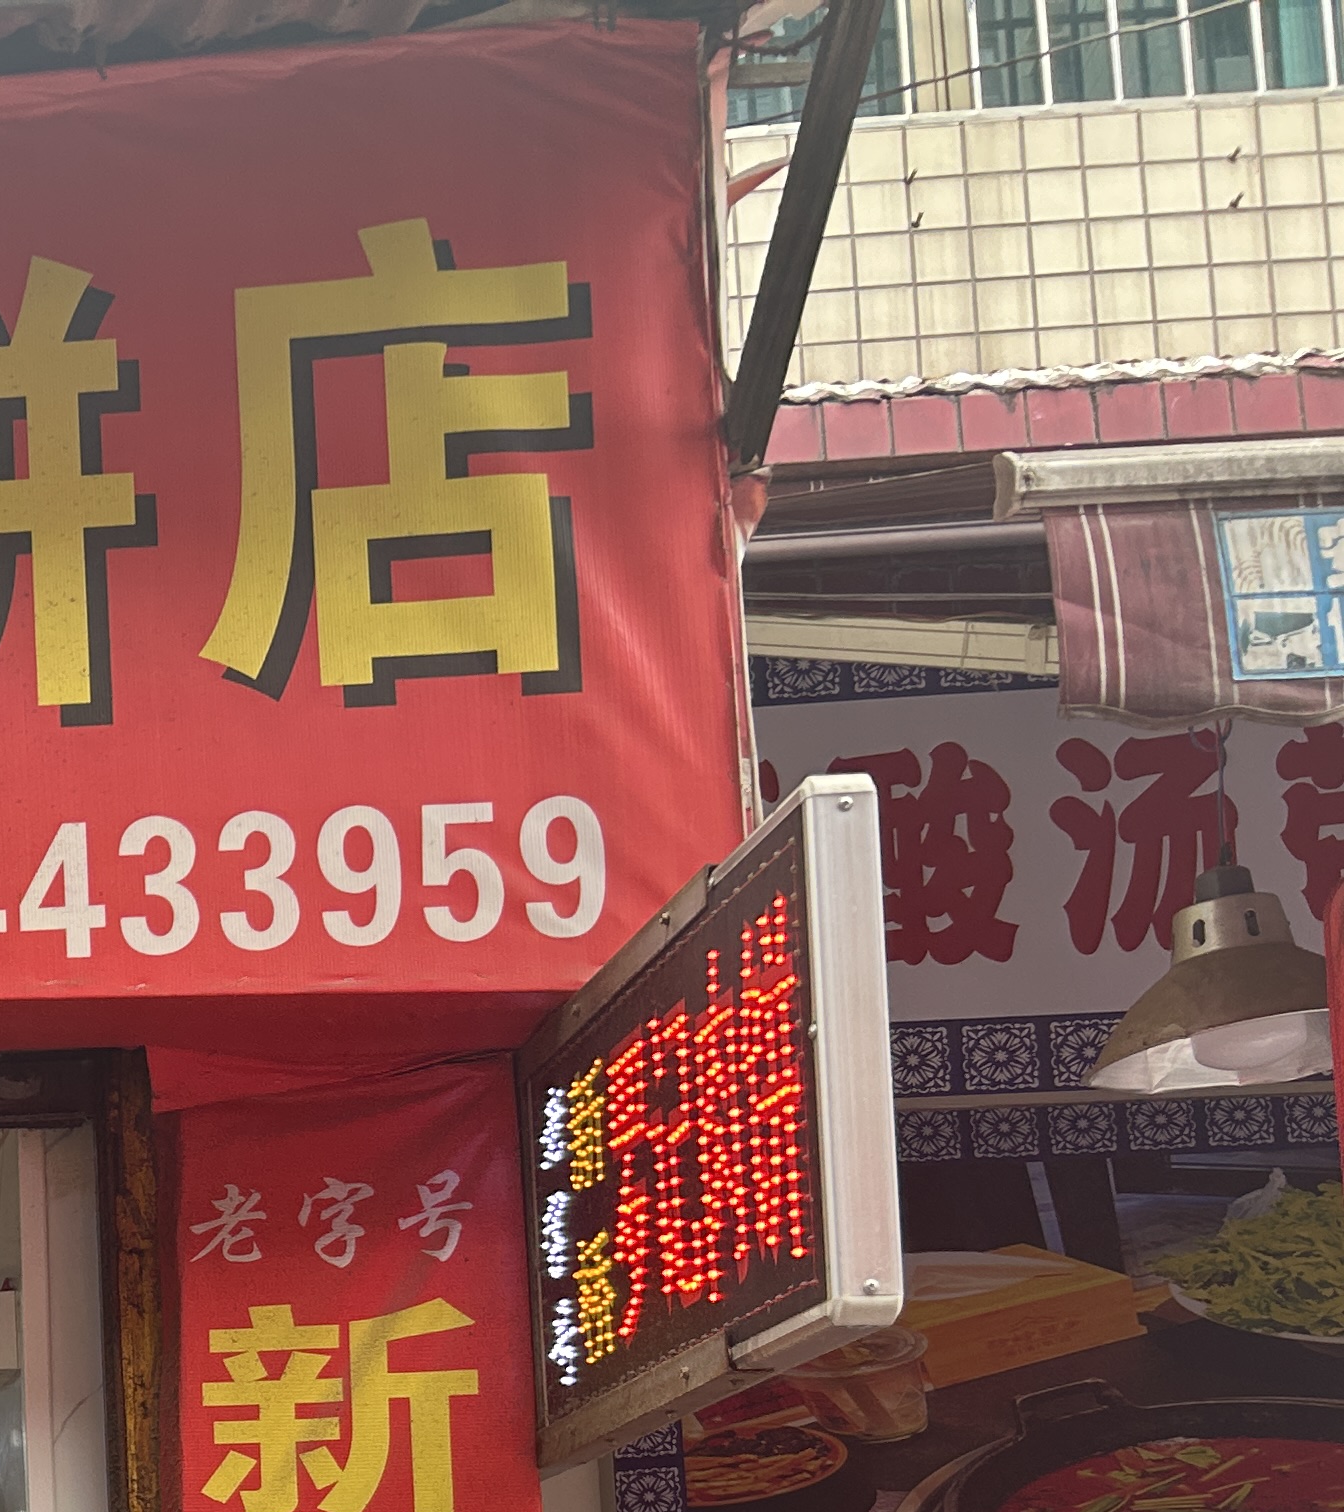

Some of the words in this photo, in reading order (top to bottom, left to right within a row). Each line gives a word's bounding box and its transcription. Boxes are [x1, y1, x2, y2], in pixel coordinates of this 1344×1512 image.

[759, 722, 1344, 972] 酸汤
[189, 1168, 475, 1270] 老字号
